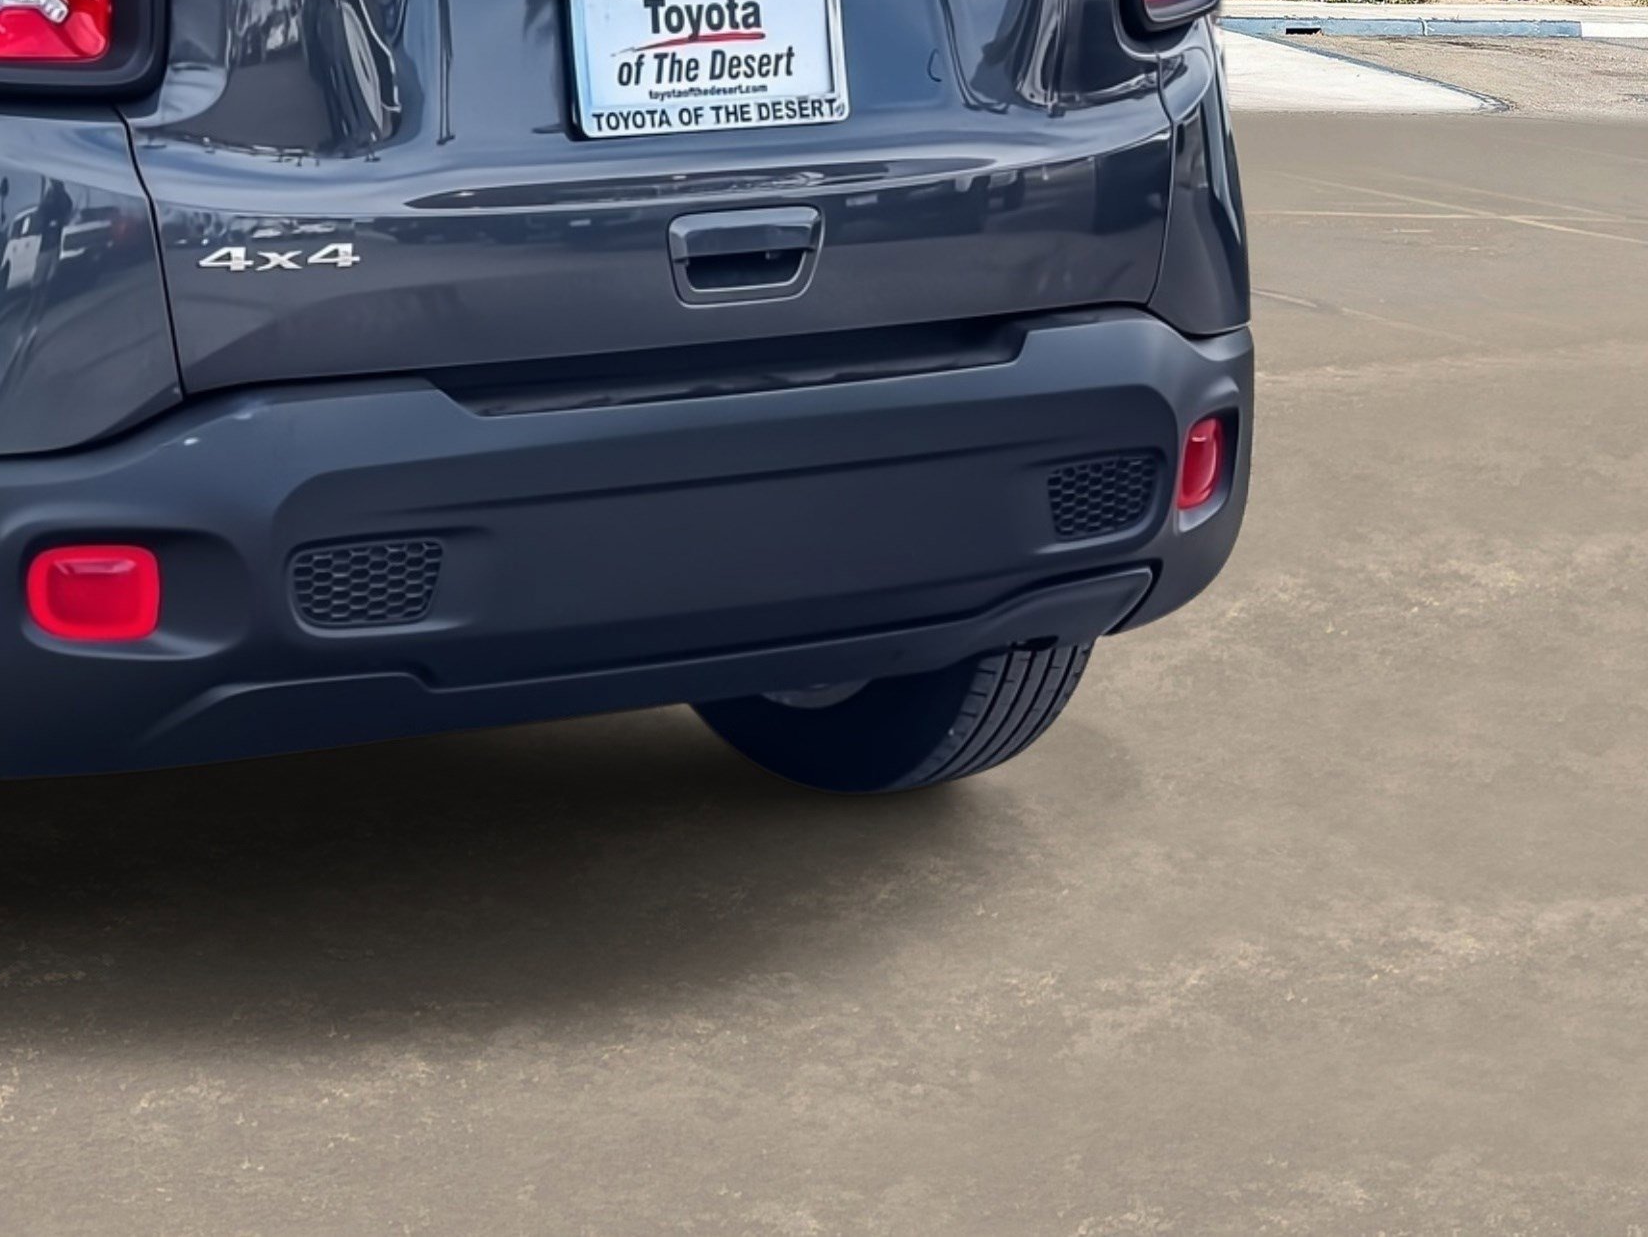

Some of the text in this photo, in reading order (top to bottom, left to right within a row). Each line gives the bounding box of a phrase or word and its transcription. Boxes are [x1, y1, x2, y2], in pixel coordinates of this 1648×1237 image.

[617, 46, 795, 86] of The Desert
[648, 84, 768, 101] toyotaofthedesert.com
[592, 98, 837, 131] TOYOTA OF THE DESERT
[199, 243, 361, 271] 4x4
